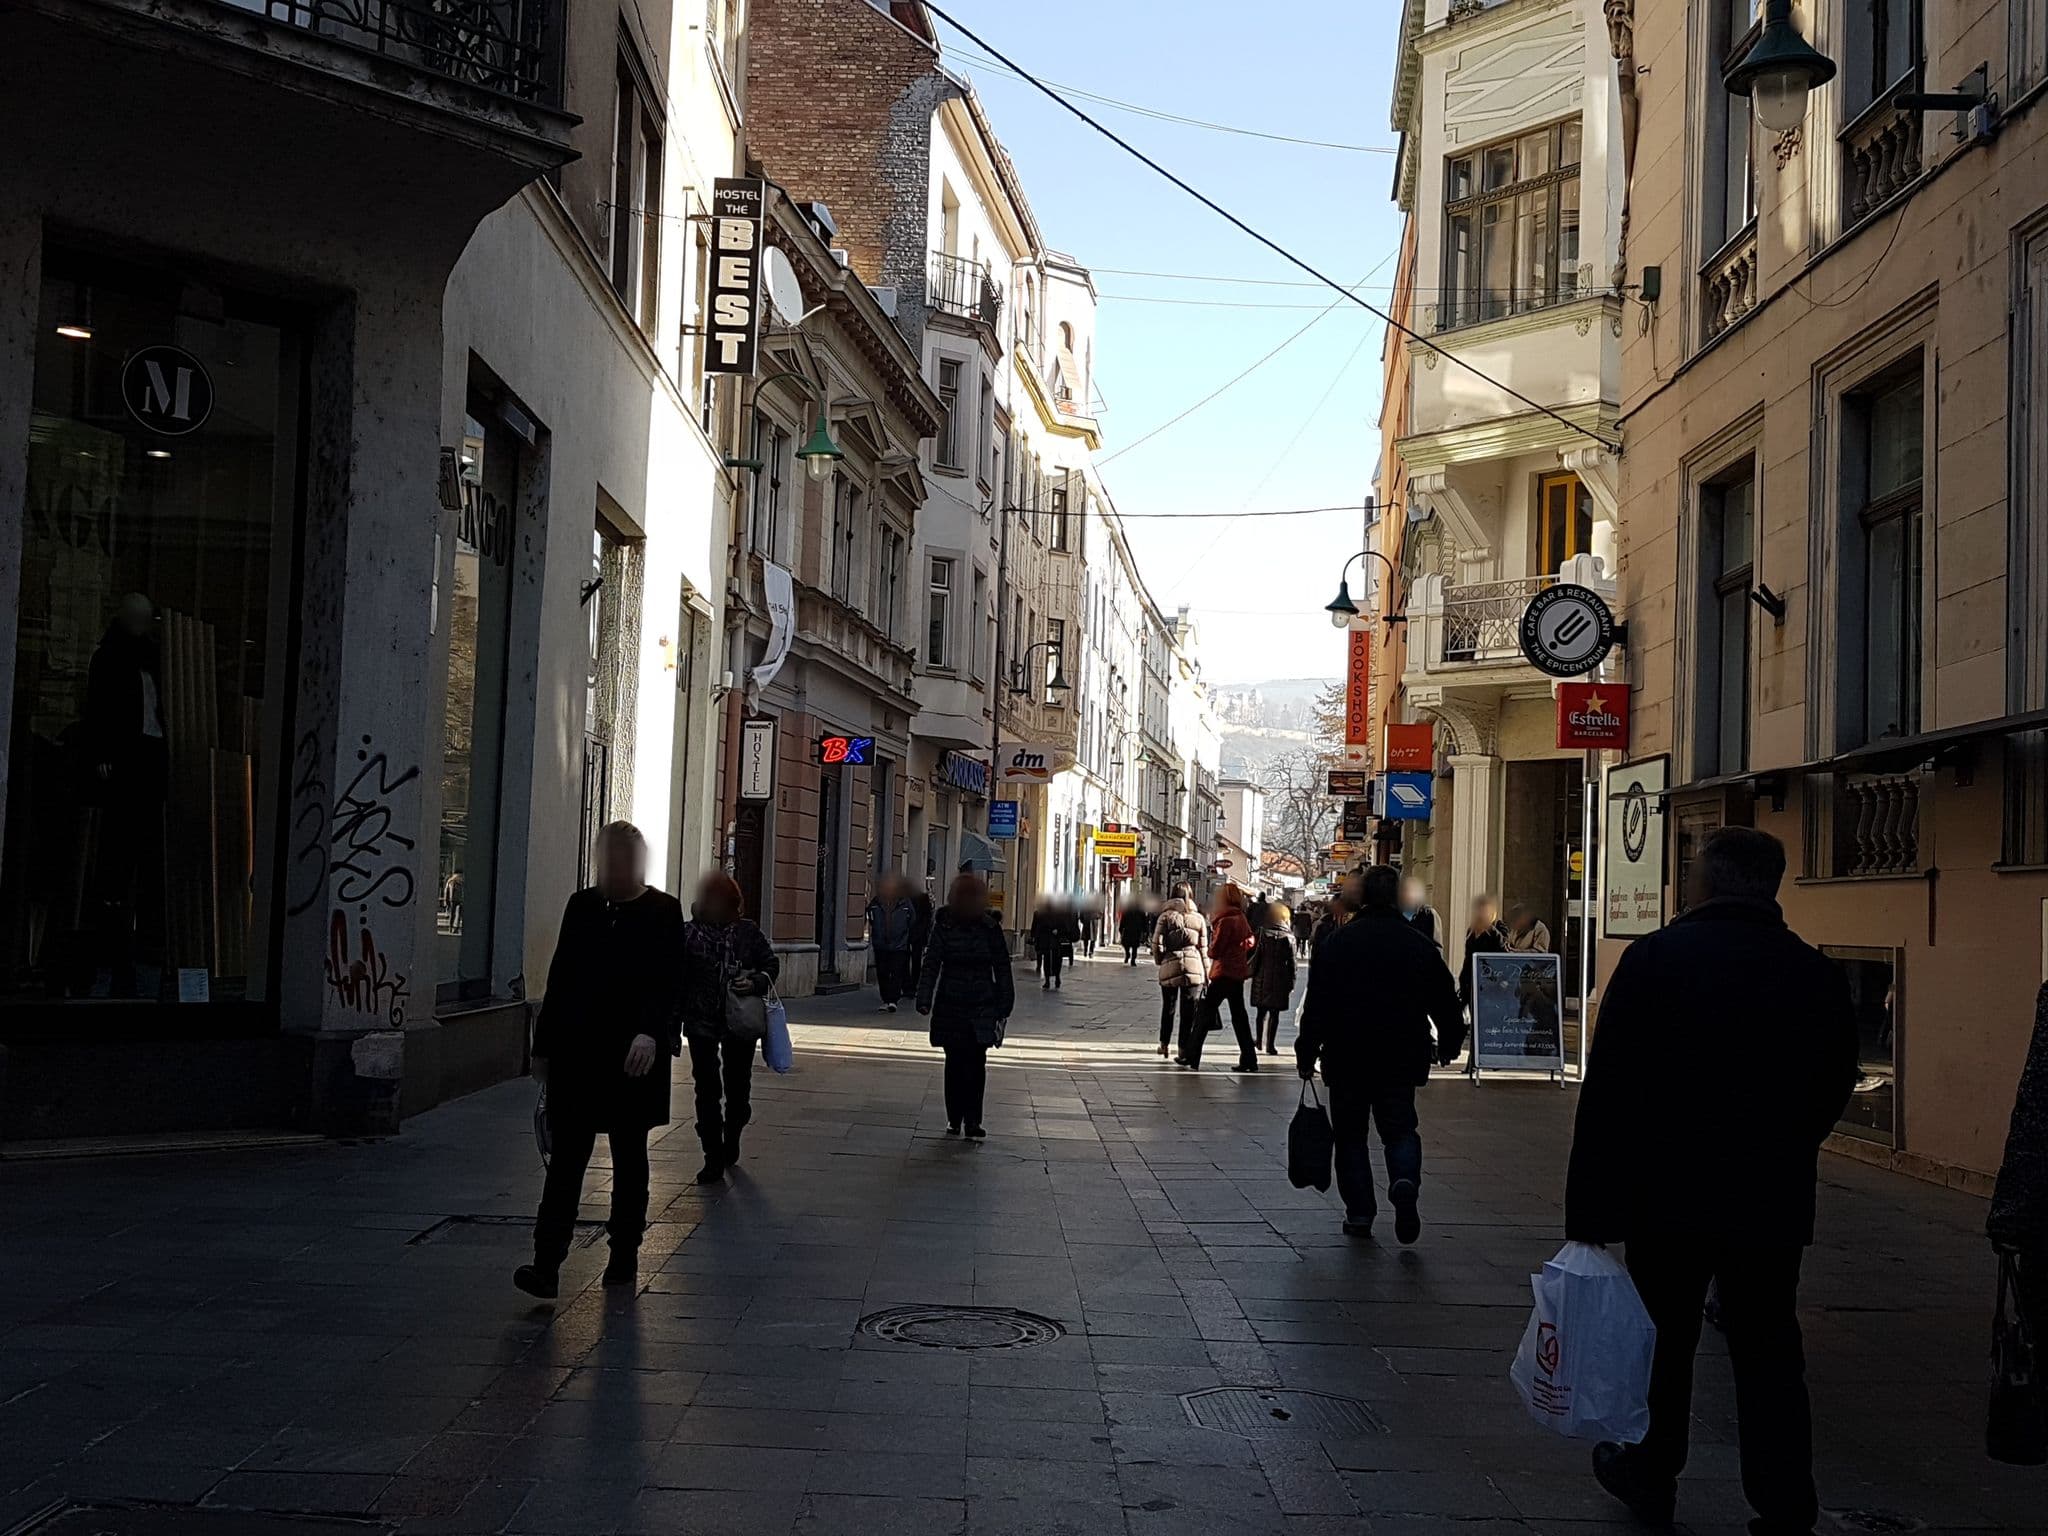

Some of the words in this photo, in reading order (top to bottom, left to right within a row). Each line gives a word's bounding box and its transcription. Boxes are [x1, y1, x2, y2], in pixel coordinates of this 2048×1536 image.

[715, 189, 761, 201] HOSTEL
[725, 204, 749, 215] THE
[714, 218, 755, 365] BEST
[1527, 609, 1539, 637] CAFE
[1536, 592, 1556, 608] BAR
[1557, 589, 1564, 597] &
[1566, 588, 1611, 638] RESTAURANT
[1531, 642, 1545, 661] THE
[1546, 646, 1606, 672] EPICENTRUM
[1351, 632, 1364, 738] BOOKSHOP
[1568, 711, 1621, 726] Estrella
[752, 733, 763, 792] HOSTEL
[822, 737, 872, 763] BK
[1012, 748, 1044, 767] dm
